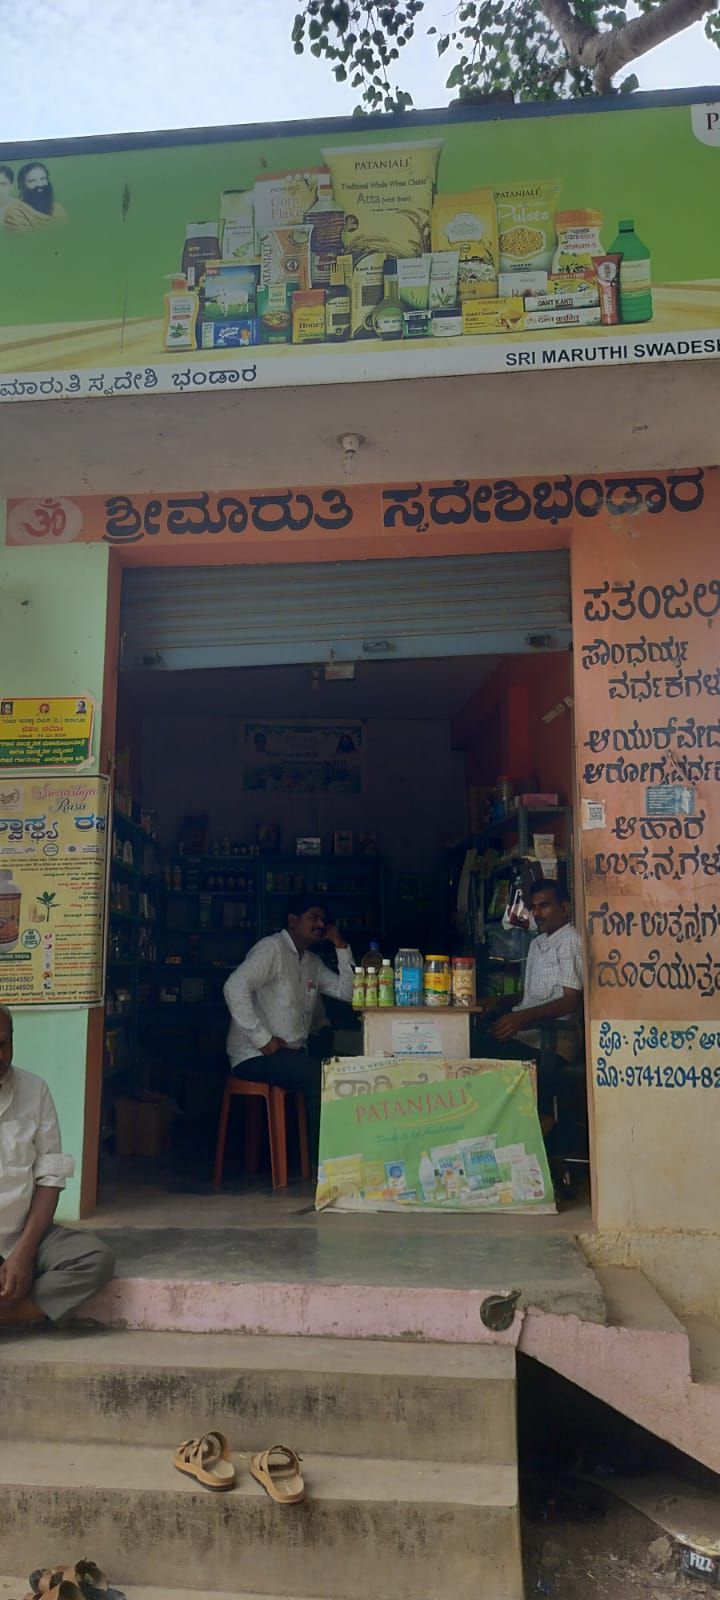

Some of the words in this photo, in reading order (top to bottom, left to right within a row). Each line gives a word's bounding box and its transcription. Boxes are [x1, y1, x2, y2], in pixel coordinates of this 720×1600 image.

[354, 158, 409, 171] PATANJALI
[357, 192, 380, 205] Atta
[495, 188, 539, 199] PATANJALI
[537, 299, 554, 307] DANT
[505, 352, 536, 366] SRI
[542, 345, 628, 364] MARUTHI
[633, 338, 720, 358] SWADES
[88, 368, 158, 395] ಸ್ವದೇಶಿ
[172, 364, 257, 391] ಭಂಡಾರ
[611, 809, 706, 840] ಆಹಾರ
[355, 1087, 467, 1124] PATANJALI
